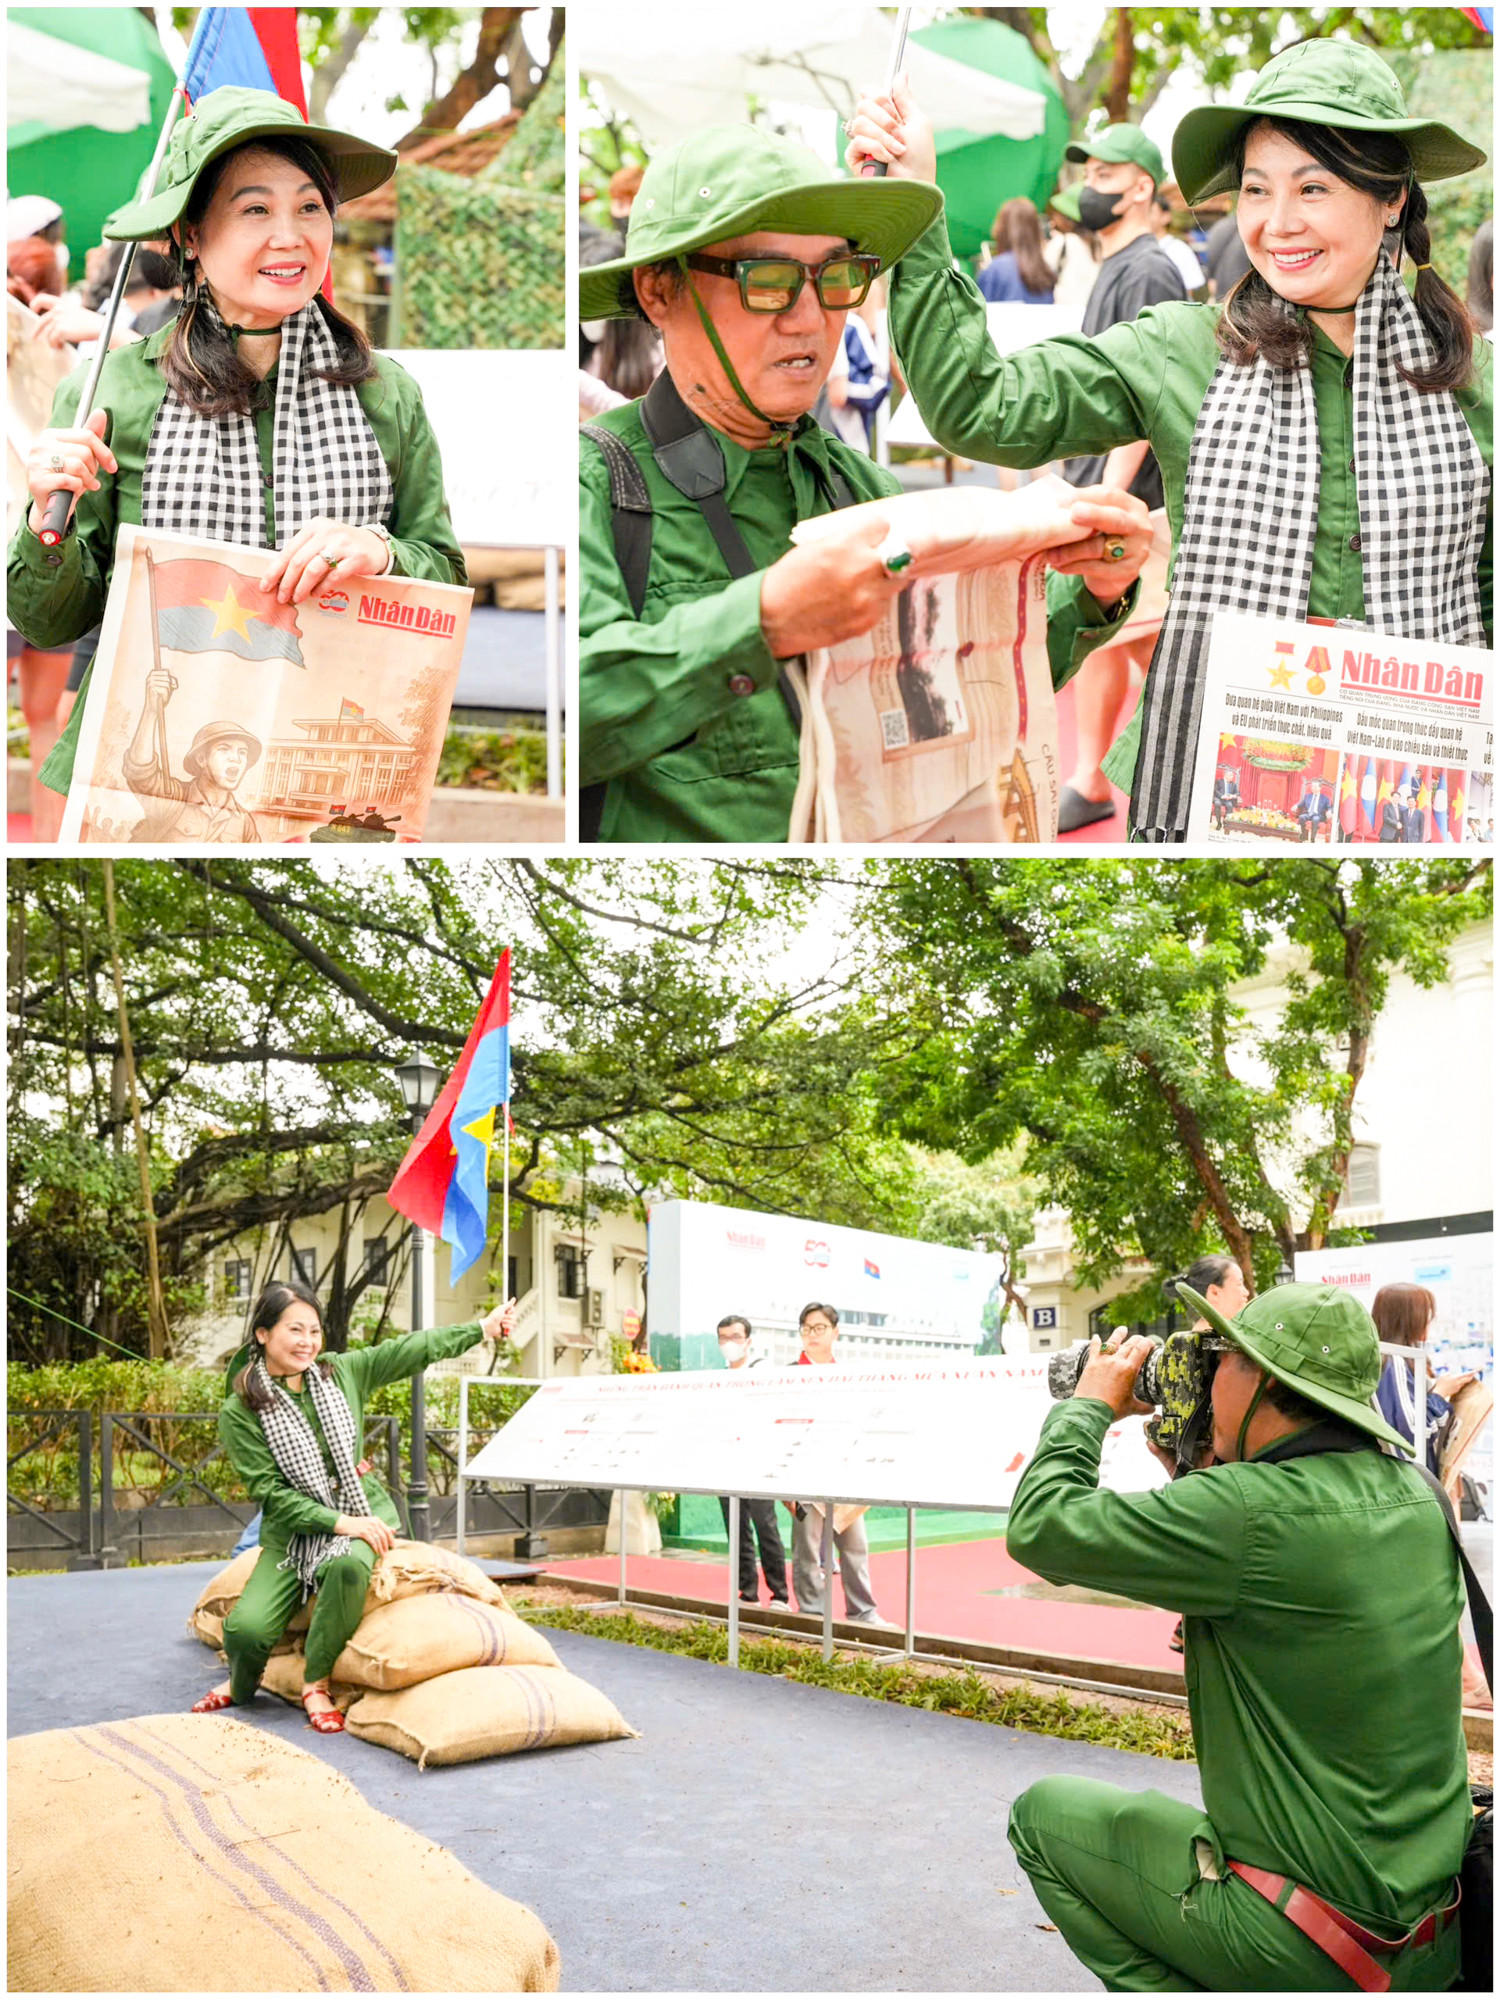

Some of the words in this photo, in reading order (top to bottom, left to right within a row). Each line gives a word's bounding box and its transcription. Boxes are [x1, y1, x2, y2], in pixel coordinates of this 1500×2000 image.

[358, 595, 415, 626] Nhân
[415, 606, 456, 634] Dân
[1341, 650, 1419, 691] Nhân
[1424, 662, 1484, 701] Dân
[1237, 695, 1252, 709] quan
[1252, 697, 1260, 713] hệ
[1261, 698, 1274, 713] giữa
[1274, 699, 1286, 716] Việt
[1286, 702, 1299, 716] Nam
[1300, 704, 1310, 718] với
[1310, 706, 1344, 723] Philippines
[1232, 712, 1240, 725] và
[1240, 714, 1247, 727] EU
[1248, 715, 1261, 729] phát
[1262, 714, 1277, 731] triển
[1321, 725, 1332, 740] quả
[1357, 710, 1368, 726] Dấu
[1382, 717, 1397, 731] quan
[1397, 719, 1414, 736] trọng
[1414, 722, 1428, 736] thúc
[1440, 726, 1455, 741] quan
[1455, 727, 1463, 744] hệ
[1347, 729, 1359, 747] Việt
[1386, 735, 1392, 750] đi
[1393, 736, 1403, 751] vào
[1404, 736, 1421, 754] chiều
[1421, 741, 1432, 756] sâu
[1433, 743, 1441, 757] và
[1036, 1309, 1053, 1326] B
